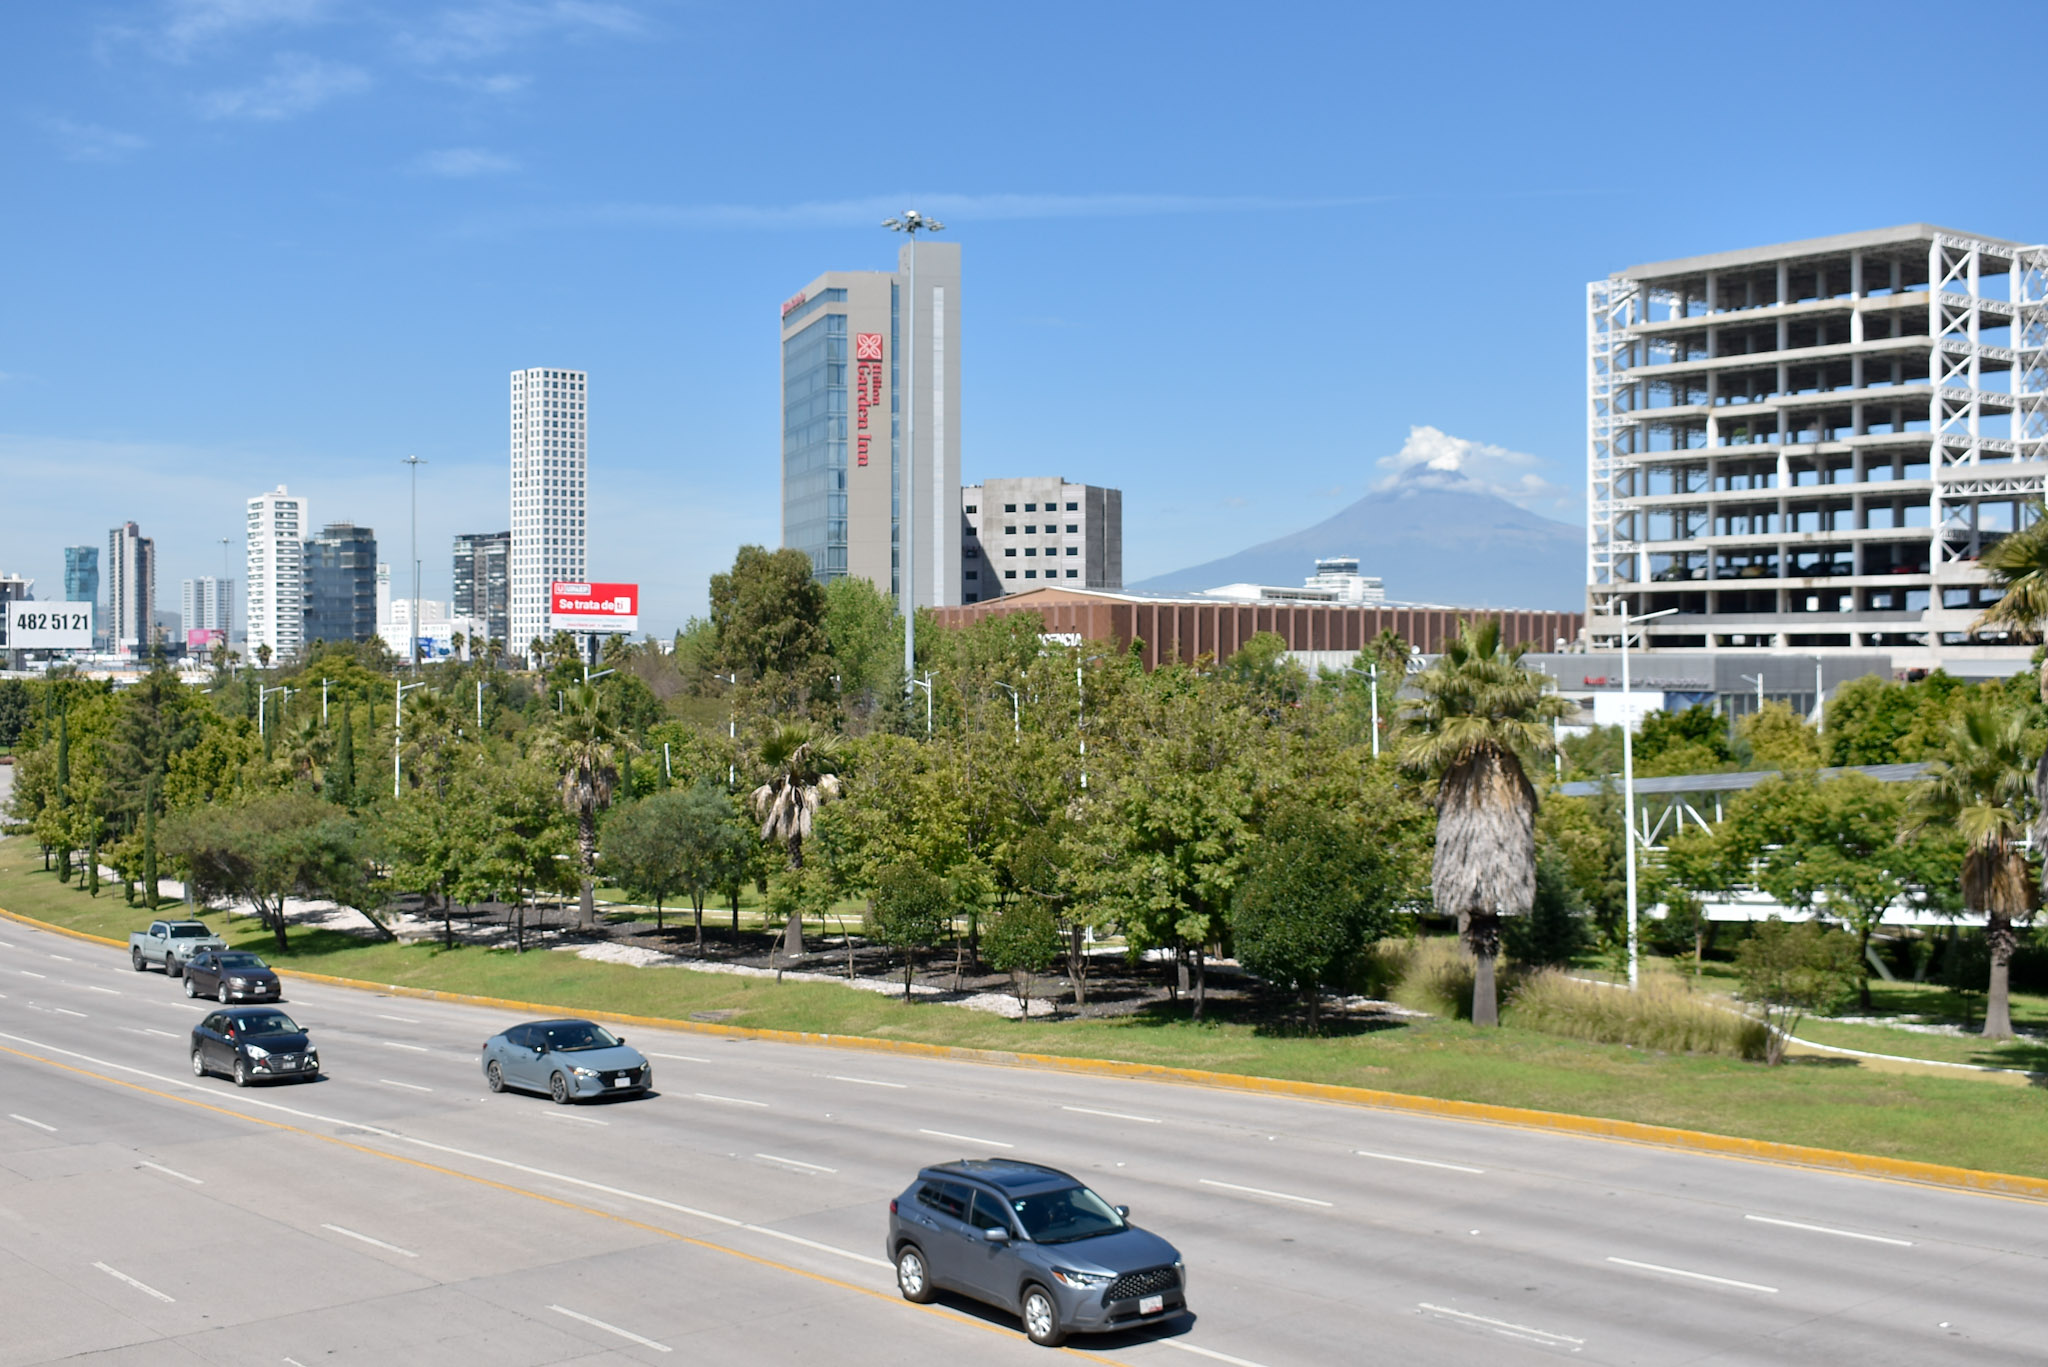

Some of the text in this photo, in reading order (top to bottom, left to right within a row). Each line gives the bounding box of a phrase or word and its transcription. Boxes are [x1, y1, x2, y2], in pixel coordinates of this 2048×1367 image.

[872, 363, 882, 406] Hilton
[857, 362, 871, 467] Garden Inn
[559, 599, 623, 610] Se trata de ti
[17, 613, 88, 630] 482 51 21
[1583, 675, 1607, 686] Audi
